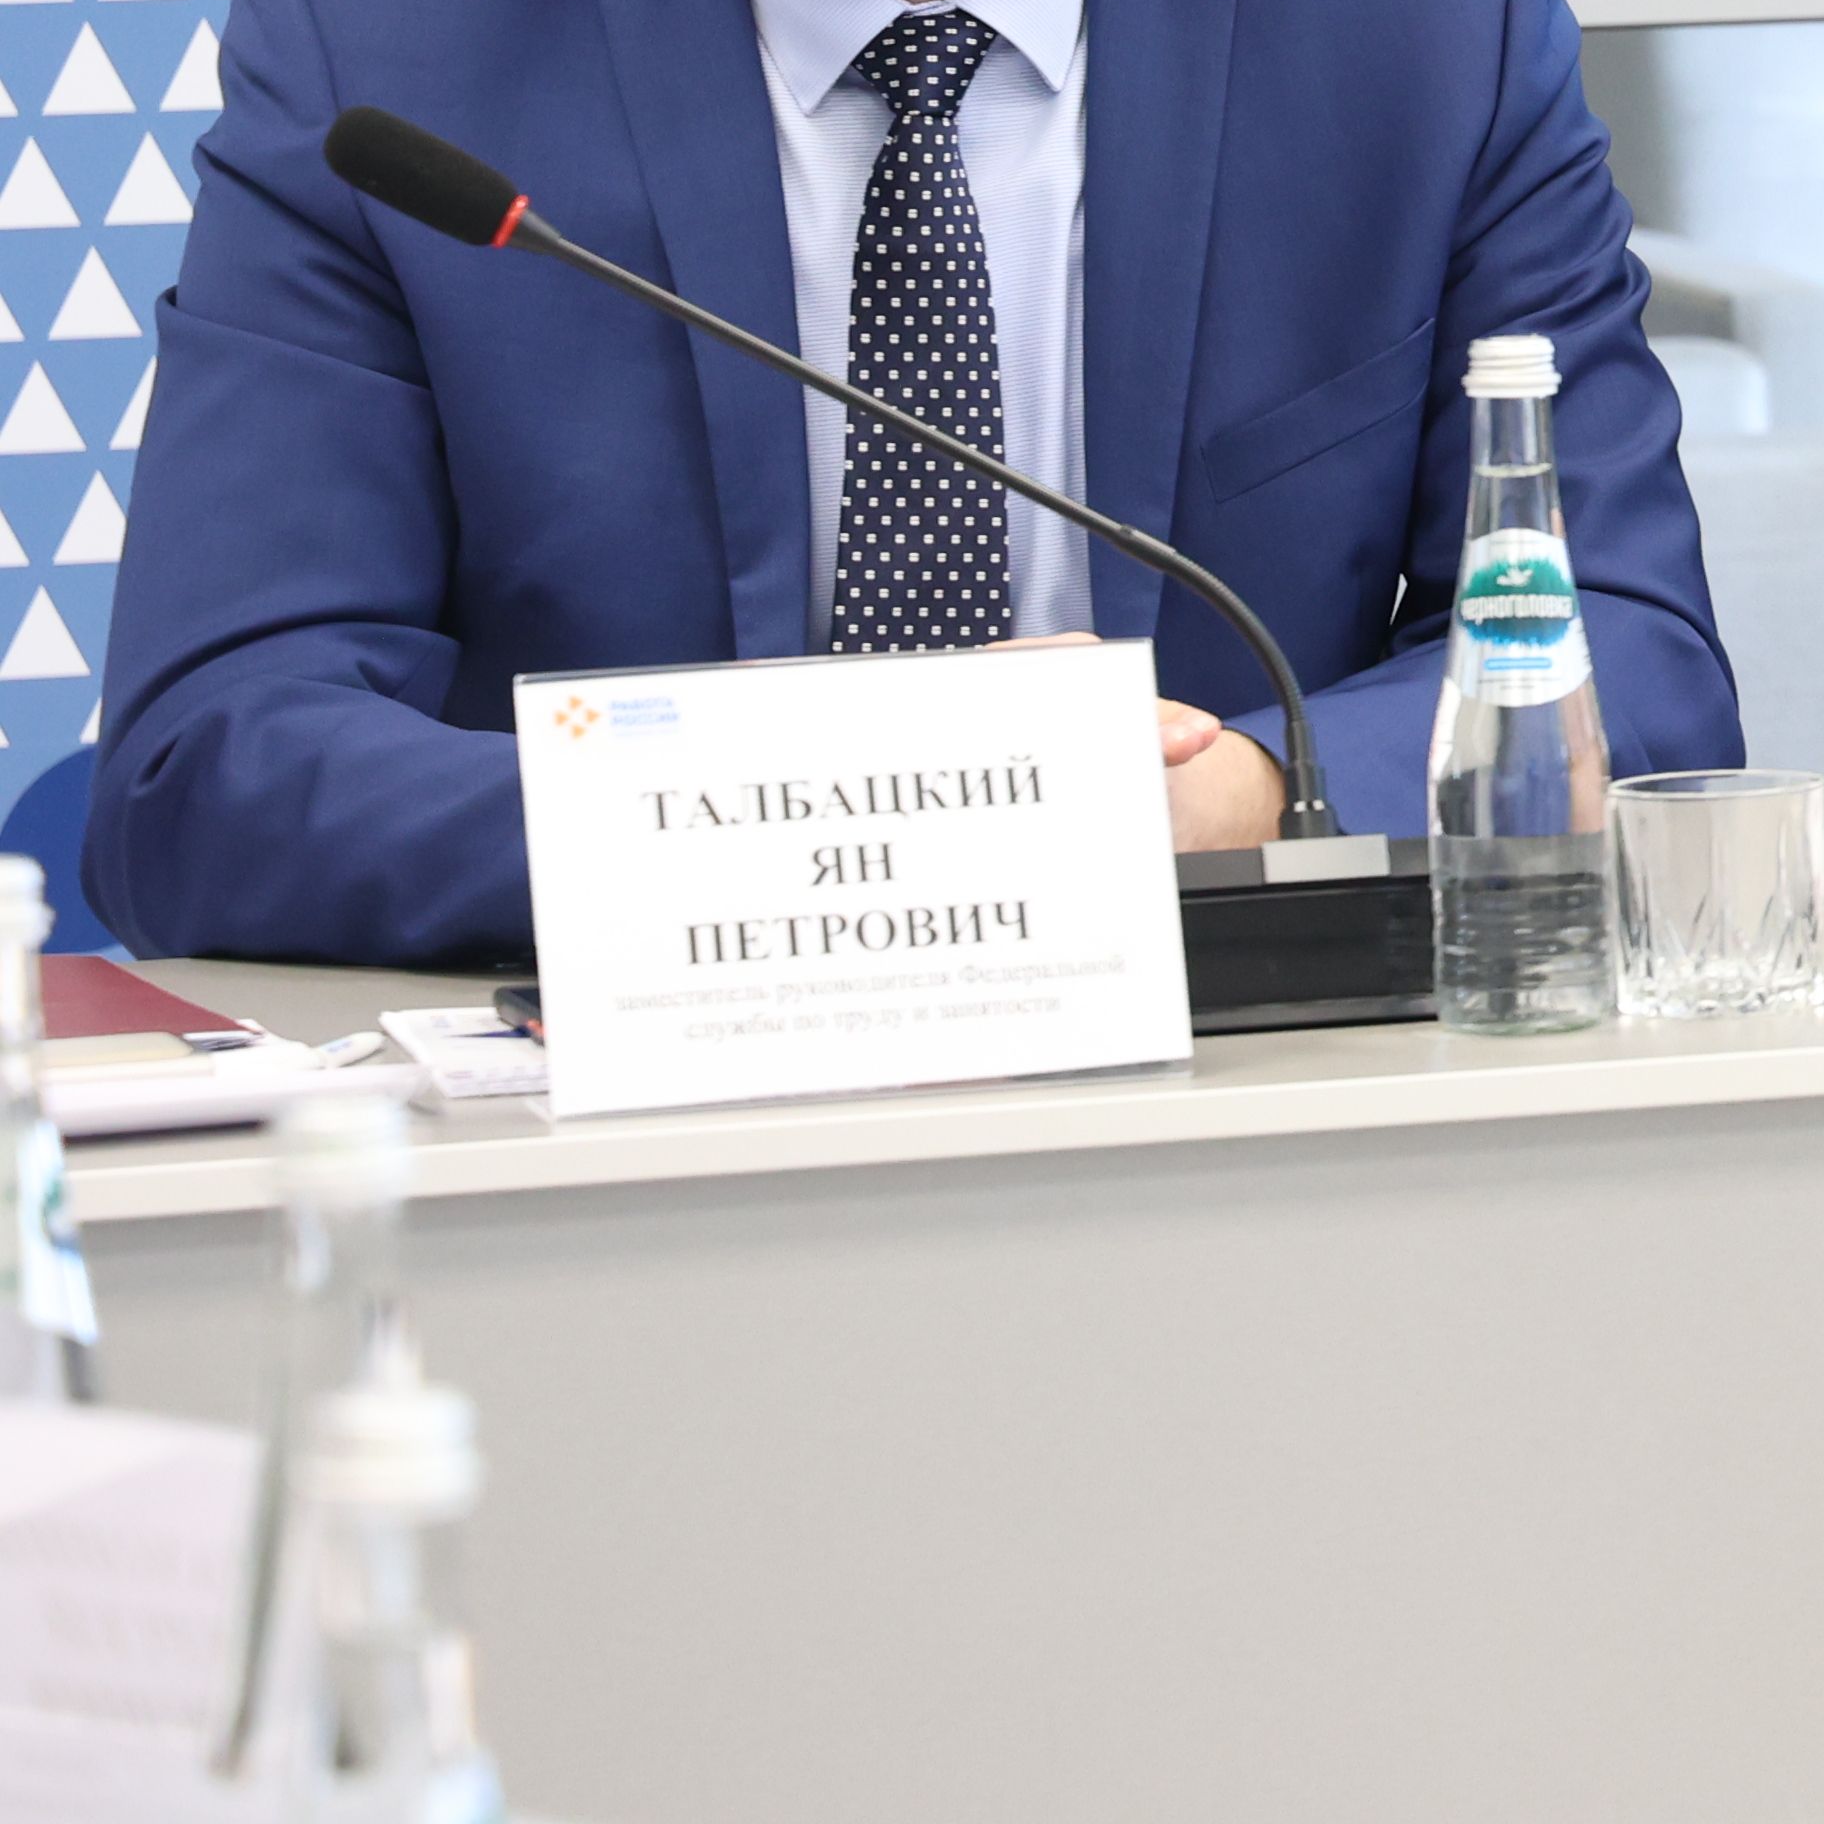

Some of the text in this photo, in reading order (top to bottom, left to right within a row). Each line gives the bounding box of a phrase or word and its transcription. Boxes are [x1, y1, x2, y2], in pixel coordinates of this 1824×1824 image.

[641, 754, 1047, 832] ТАЛБАЦКИЙ
[810, 842, 895, 886] ЯН
[686, 899, 1032, 966] ПЕТРОВИЧ
